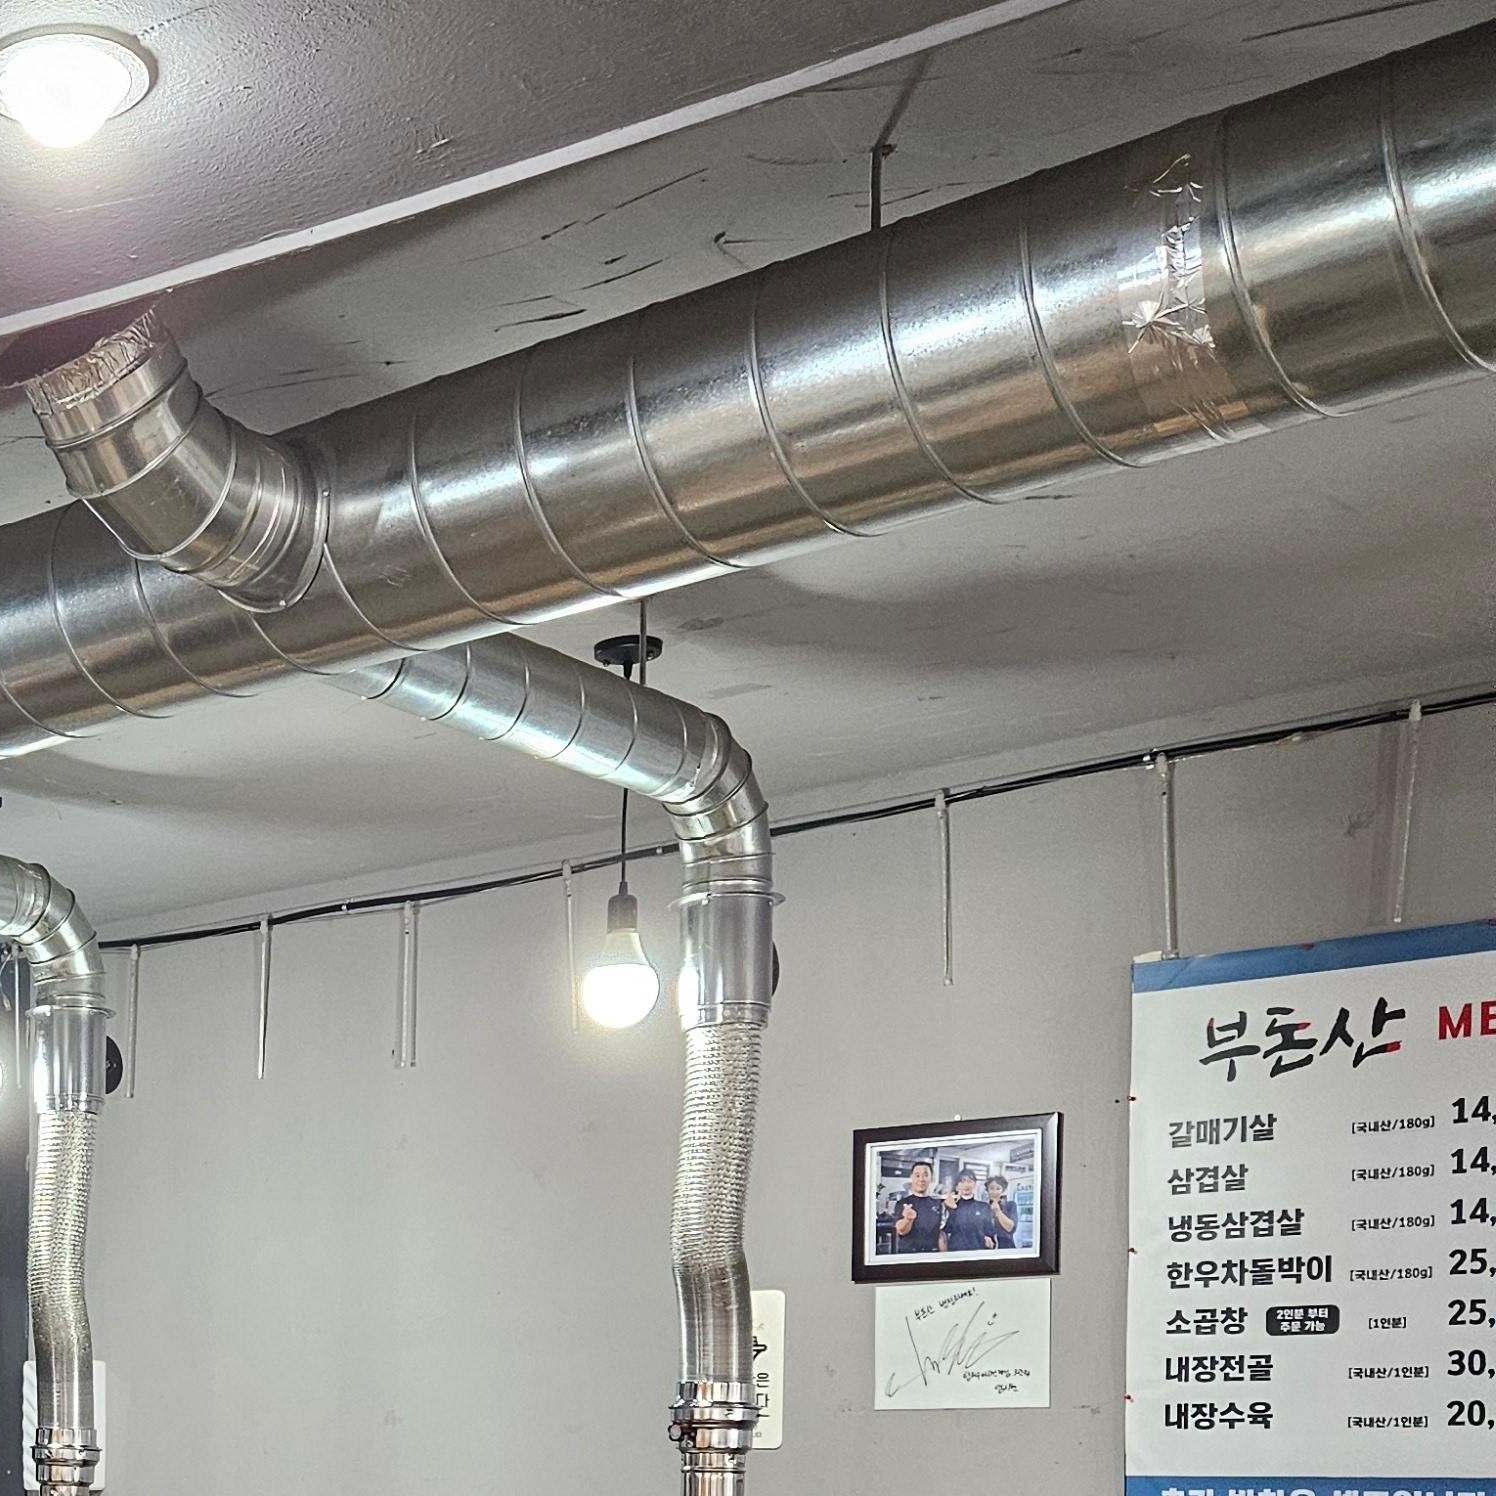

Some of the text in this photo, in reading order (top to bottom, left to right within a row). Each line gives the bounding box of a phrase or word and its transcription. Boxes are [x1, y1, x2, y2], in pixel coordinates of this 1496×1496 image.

[1199, 997, 1406, 1081] 부돈산
[1168, 1114, 1277, 1148] 갈매기살
[1167, 1164, 1249, 1195] 삼겹살
[1168, 1208, 1304, 1243] 냉동삼겹살
[1166, 1255, 1332, 1289] 한우차돌박이
[1166, 1306, 1248, 1335] 소곱창
[1165, 1354, 1274, 1383] 내장전골
[1164, 1401, 1274, 1430] 내장수육
